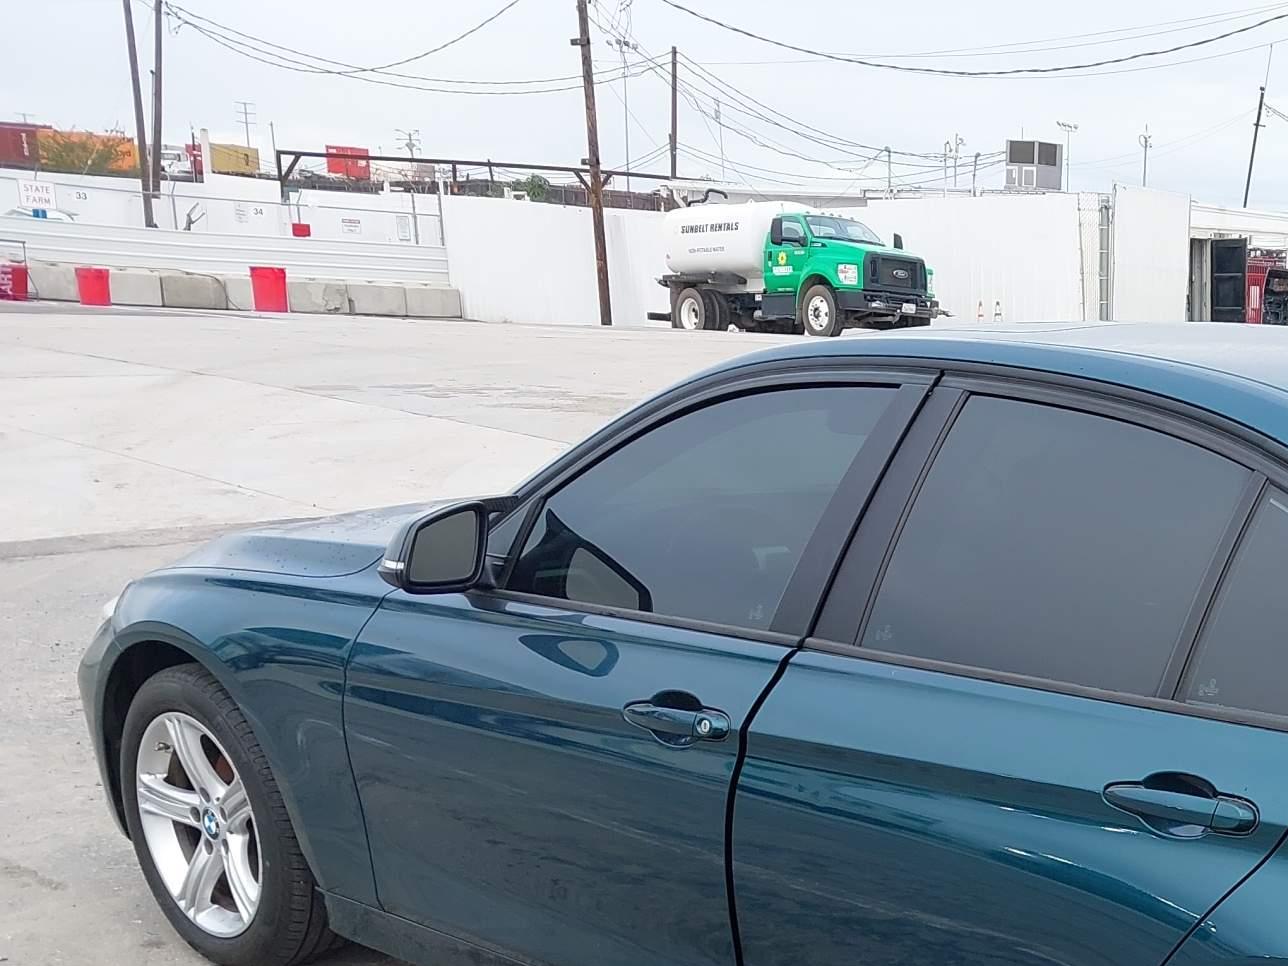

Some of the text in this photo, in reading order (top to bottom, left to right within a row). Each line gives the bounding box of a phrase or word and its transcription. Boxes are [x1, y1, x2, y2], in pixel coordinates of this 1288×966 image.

[23, 184, 51, 194] STATE
[25, 195, 51, 205] FARM
[75, 191, 88, 200] 33
[253, 207, 264, 216] 34
[681, 221, 739, 234] SUNBELT RENTALS
